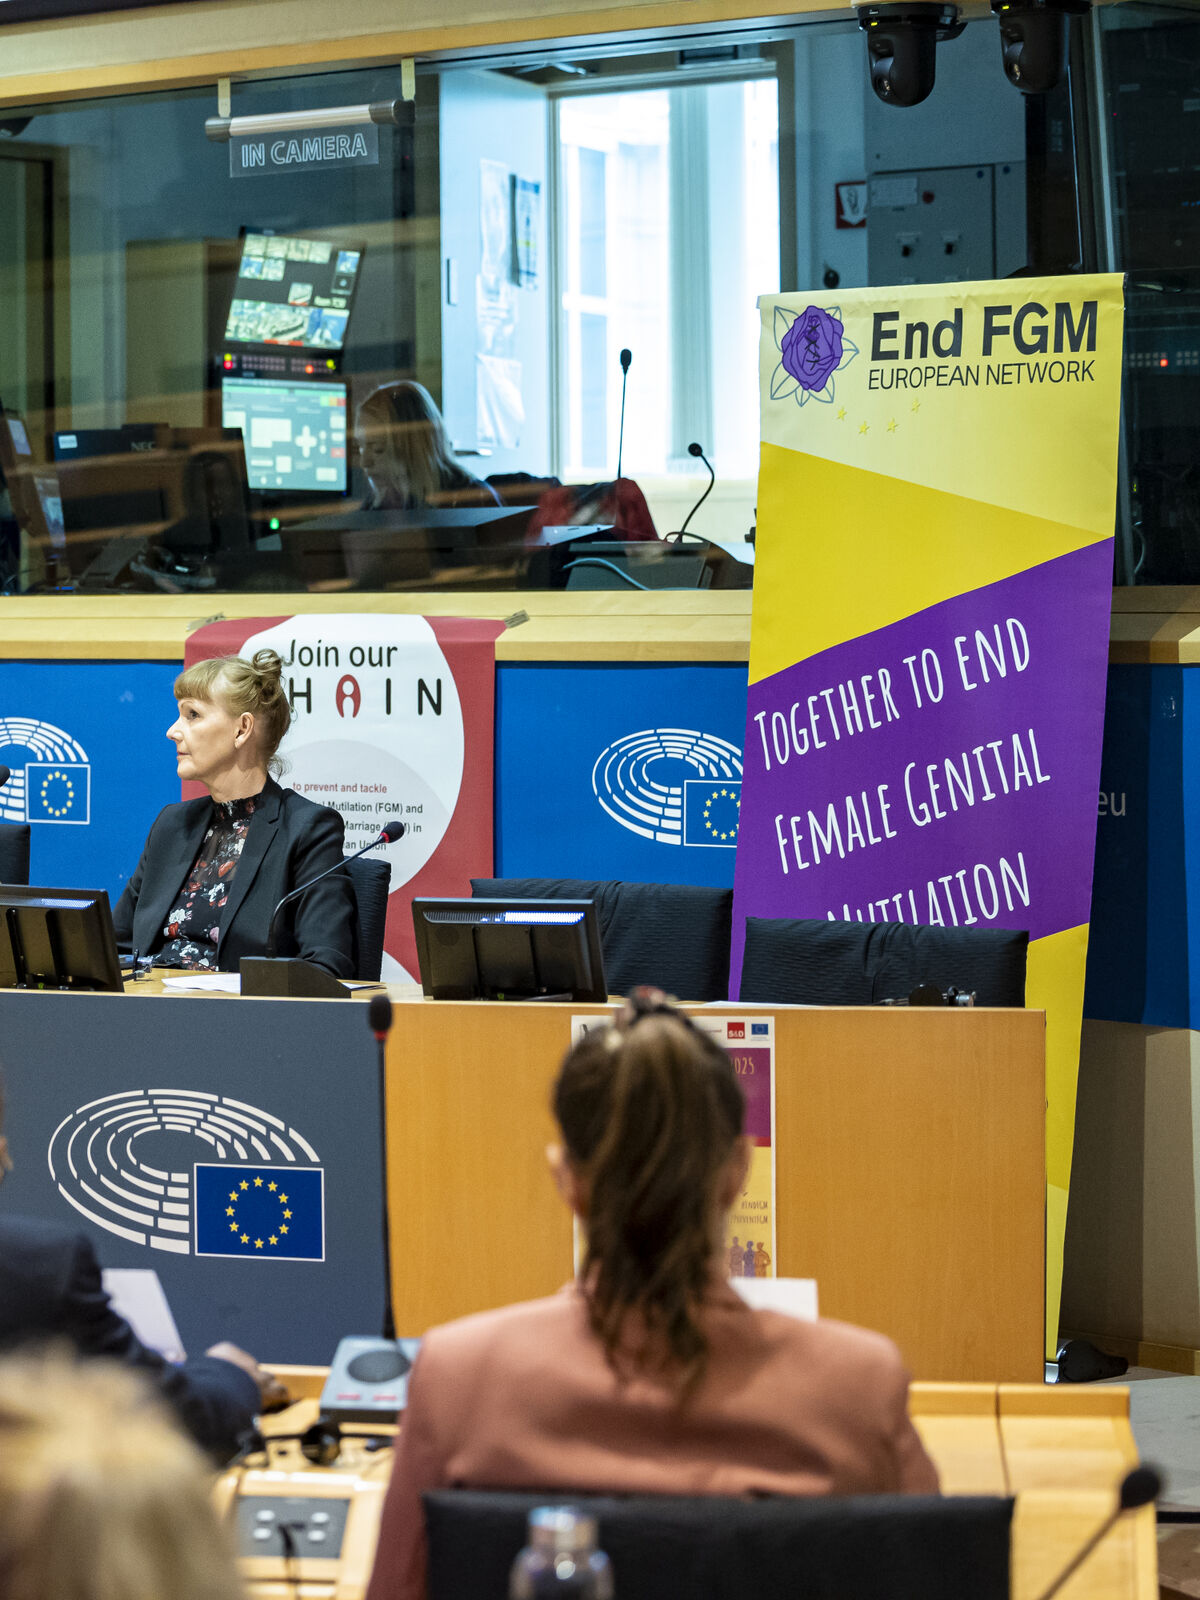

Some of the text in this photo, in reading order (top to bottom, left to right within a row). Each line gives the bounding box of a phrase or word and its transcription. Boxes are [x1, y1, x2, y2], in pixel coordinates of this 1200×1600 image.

[241, 132, 367, 168] IN CAMERA
[870, 300, 1098, 362] End FGM
[868, 359, 1096, 391] EUROPEAN NETWORK
[284, 639, 398, 668] Join our
[288, 673, 442, 719] HAIN
[754, 618, 1031, 771] TOGETHER TO END
[304, 783, 338, 793] prevent
[341, 783, 357, 793] and
[360, 783, 387, 794] tackle
[775, 728, 1051, 874] FEMALE GENITAL
[375, 802, 403, 815] (FGM)
[405, 804, 423, 813] and
[413, 822, 422, 833] in
[728, 1031, 745, 1039] S&D
[733, 1057, 755, 1075] 025
